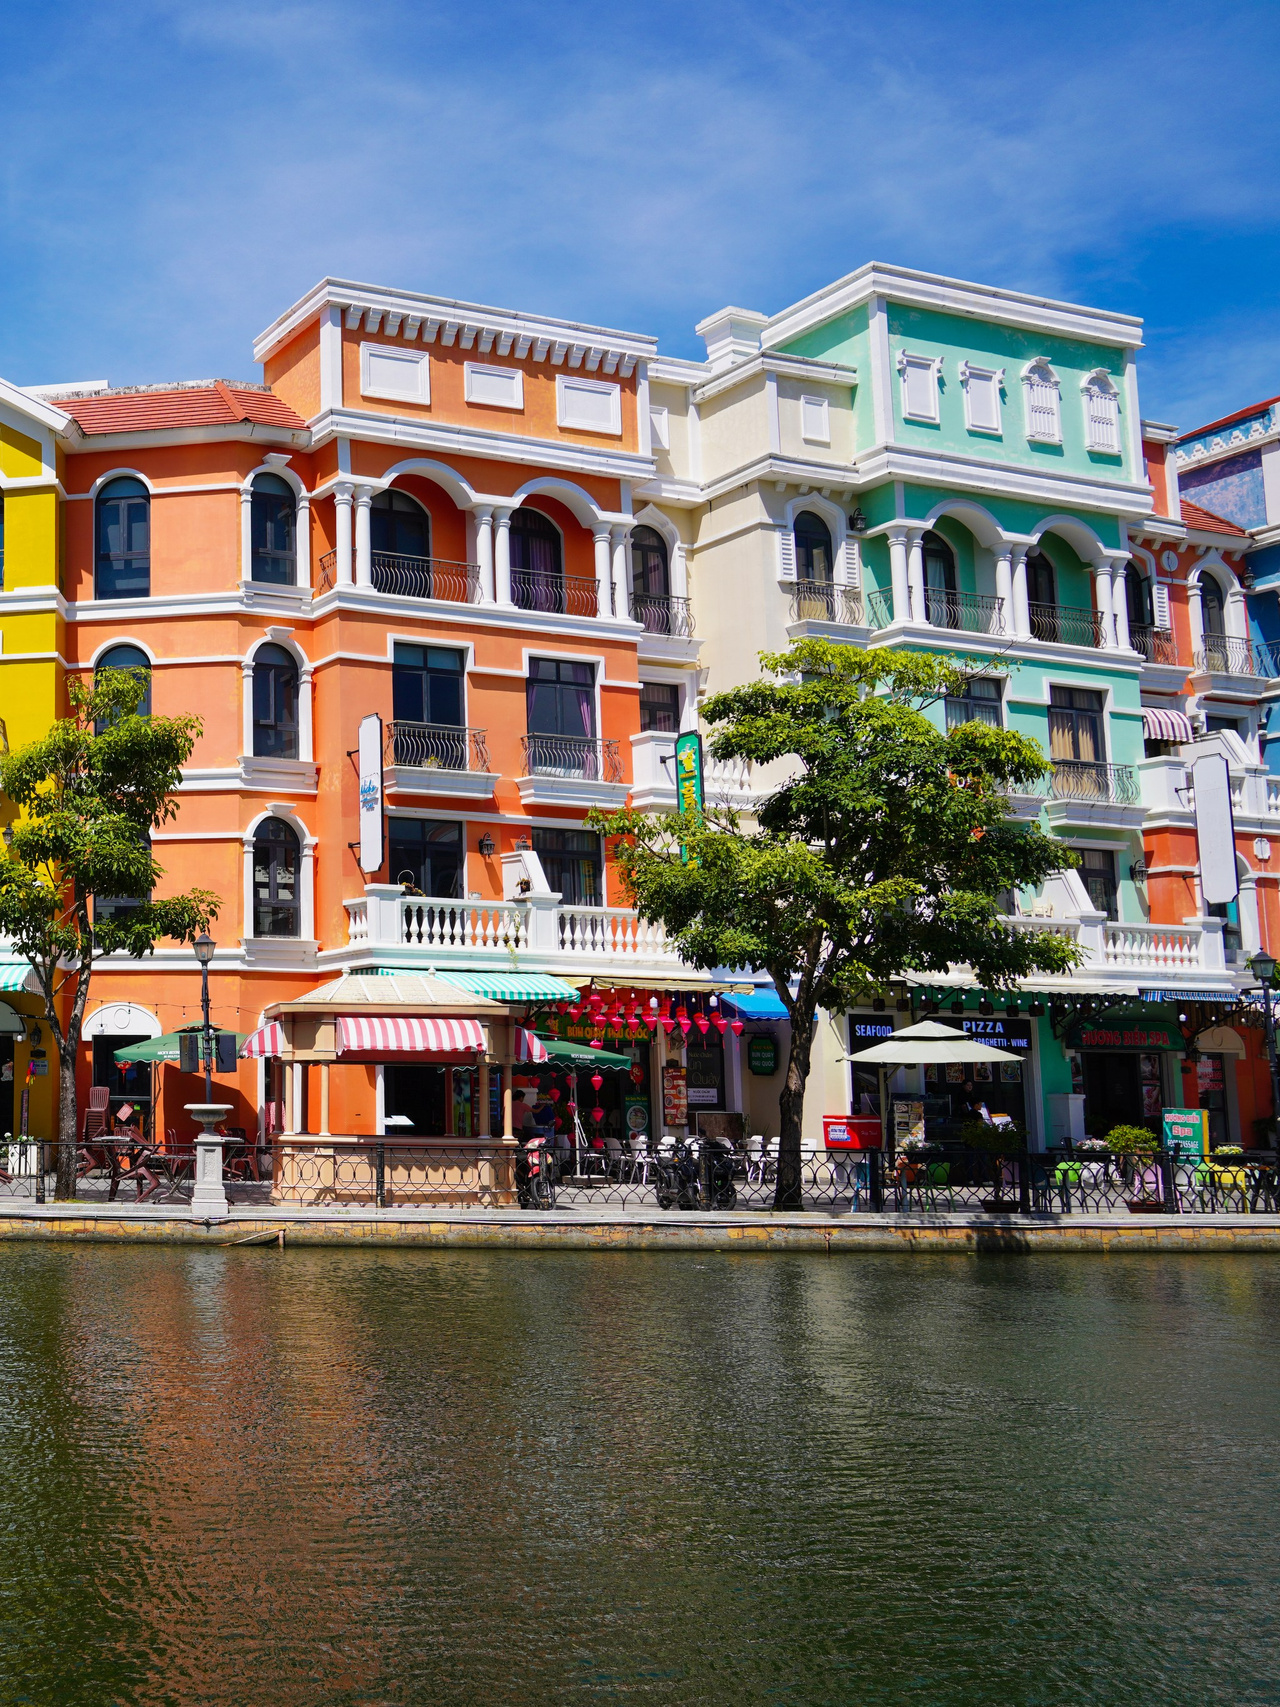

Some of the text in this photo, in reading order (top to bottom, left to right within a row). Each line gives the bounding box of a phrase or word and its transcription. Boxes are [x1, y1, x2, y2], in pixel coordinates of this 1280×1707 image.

[855, 1024, 893, 1038] SEAFOOD
[962, 1021, 1004, 1033] PIZZA
[973, 1037, 1028, 1048] SPAGHETTI WINE
[1149, 1031, 1170, 1046] SPA
[1172, 1125, 1193, 1137] Spa
